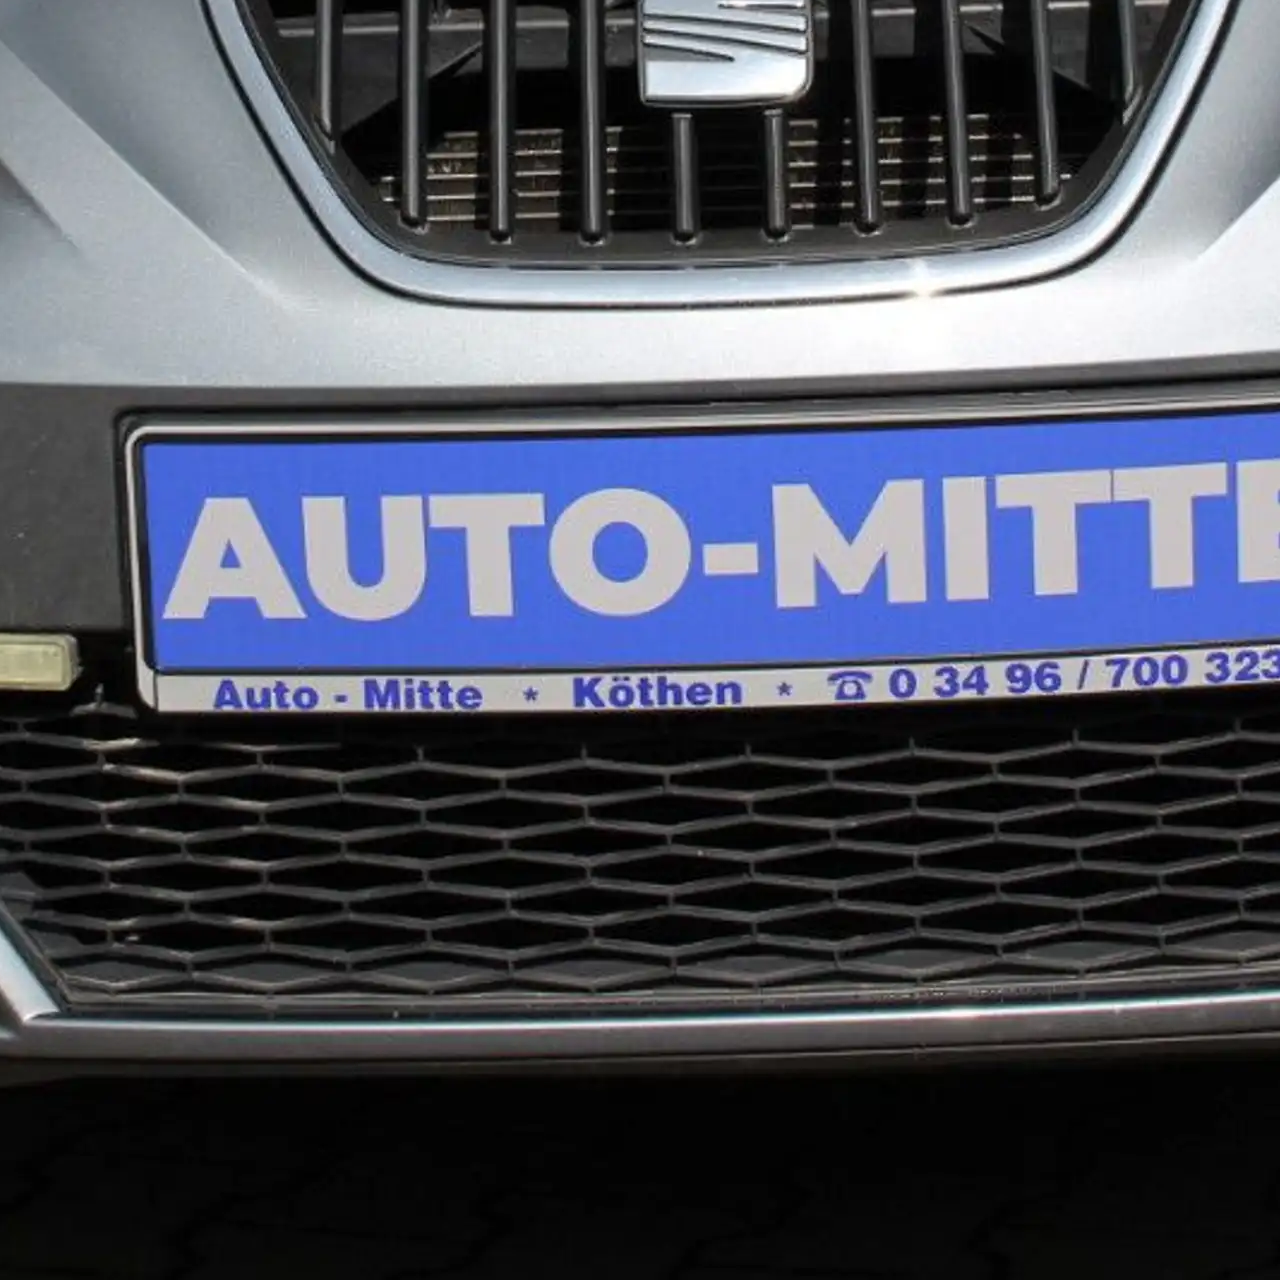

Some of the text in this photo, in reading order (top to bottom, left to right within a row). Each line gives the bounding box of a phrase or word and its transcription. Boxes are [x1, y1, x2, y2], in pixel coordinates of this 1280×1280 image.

[213, 677, 320, 711] Auto
[363, 677, 484, 710] Mitte
[572, 676, 743, 710] Köthen
[888, 667, 918, 700] 0
[933, 665, 990, 699] 34
[1005, 661, 1063, 695] 96
[1105, 654, 1189, 688] 700
